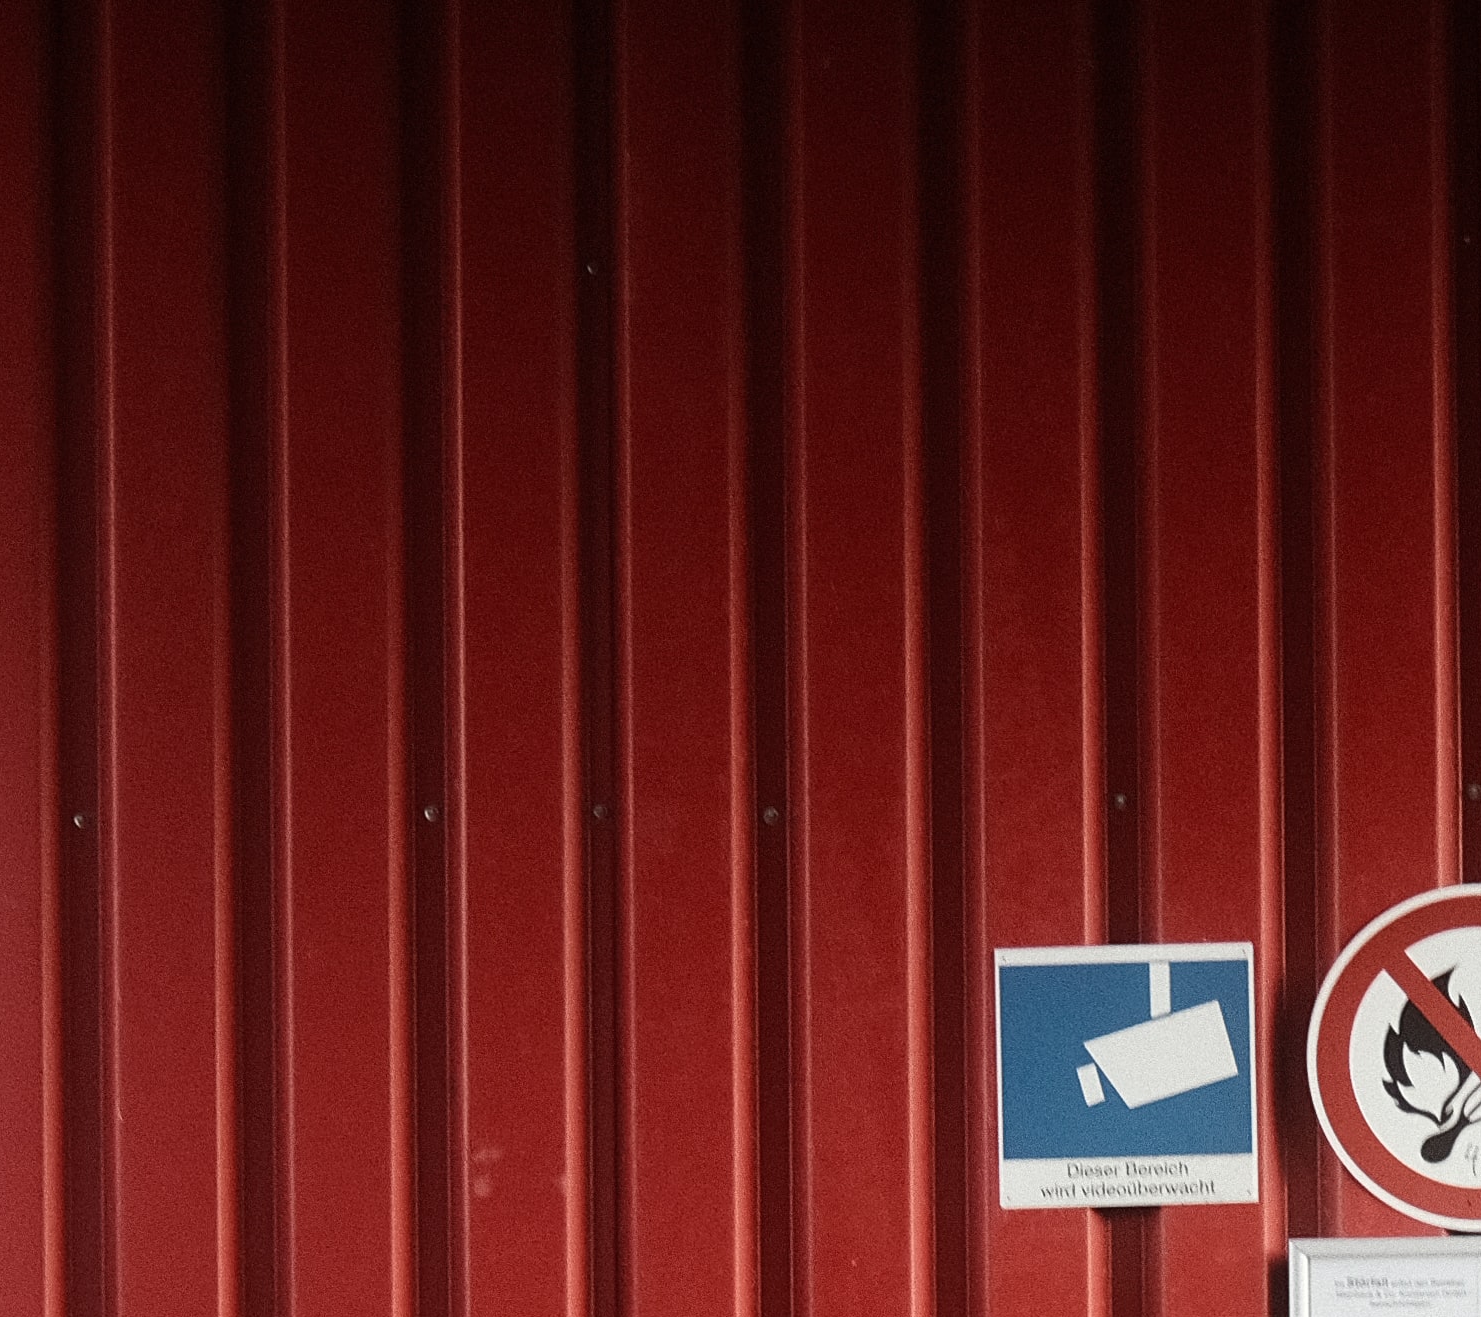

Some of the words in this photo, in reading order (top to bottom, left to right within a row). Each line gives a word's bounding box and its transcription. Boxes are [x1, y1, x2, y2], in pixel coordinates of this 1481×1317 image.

[1067, 1162, 1120, 1178] Dieser
[1125, 1160, 1189, 1176] Bereich
[1040, 1182, 1076, 1198] wird
[1081, 1178, 1216, 1197] videoüberwacht
